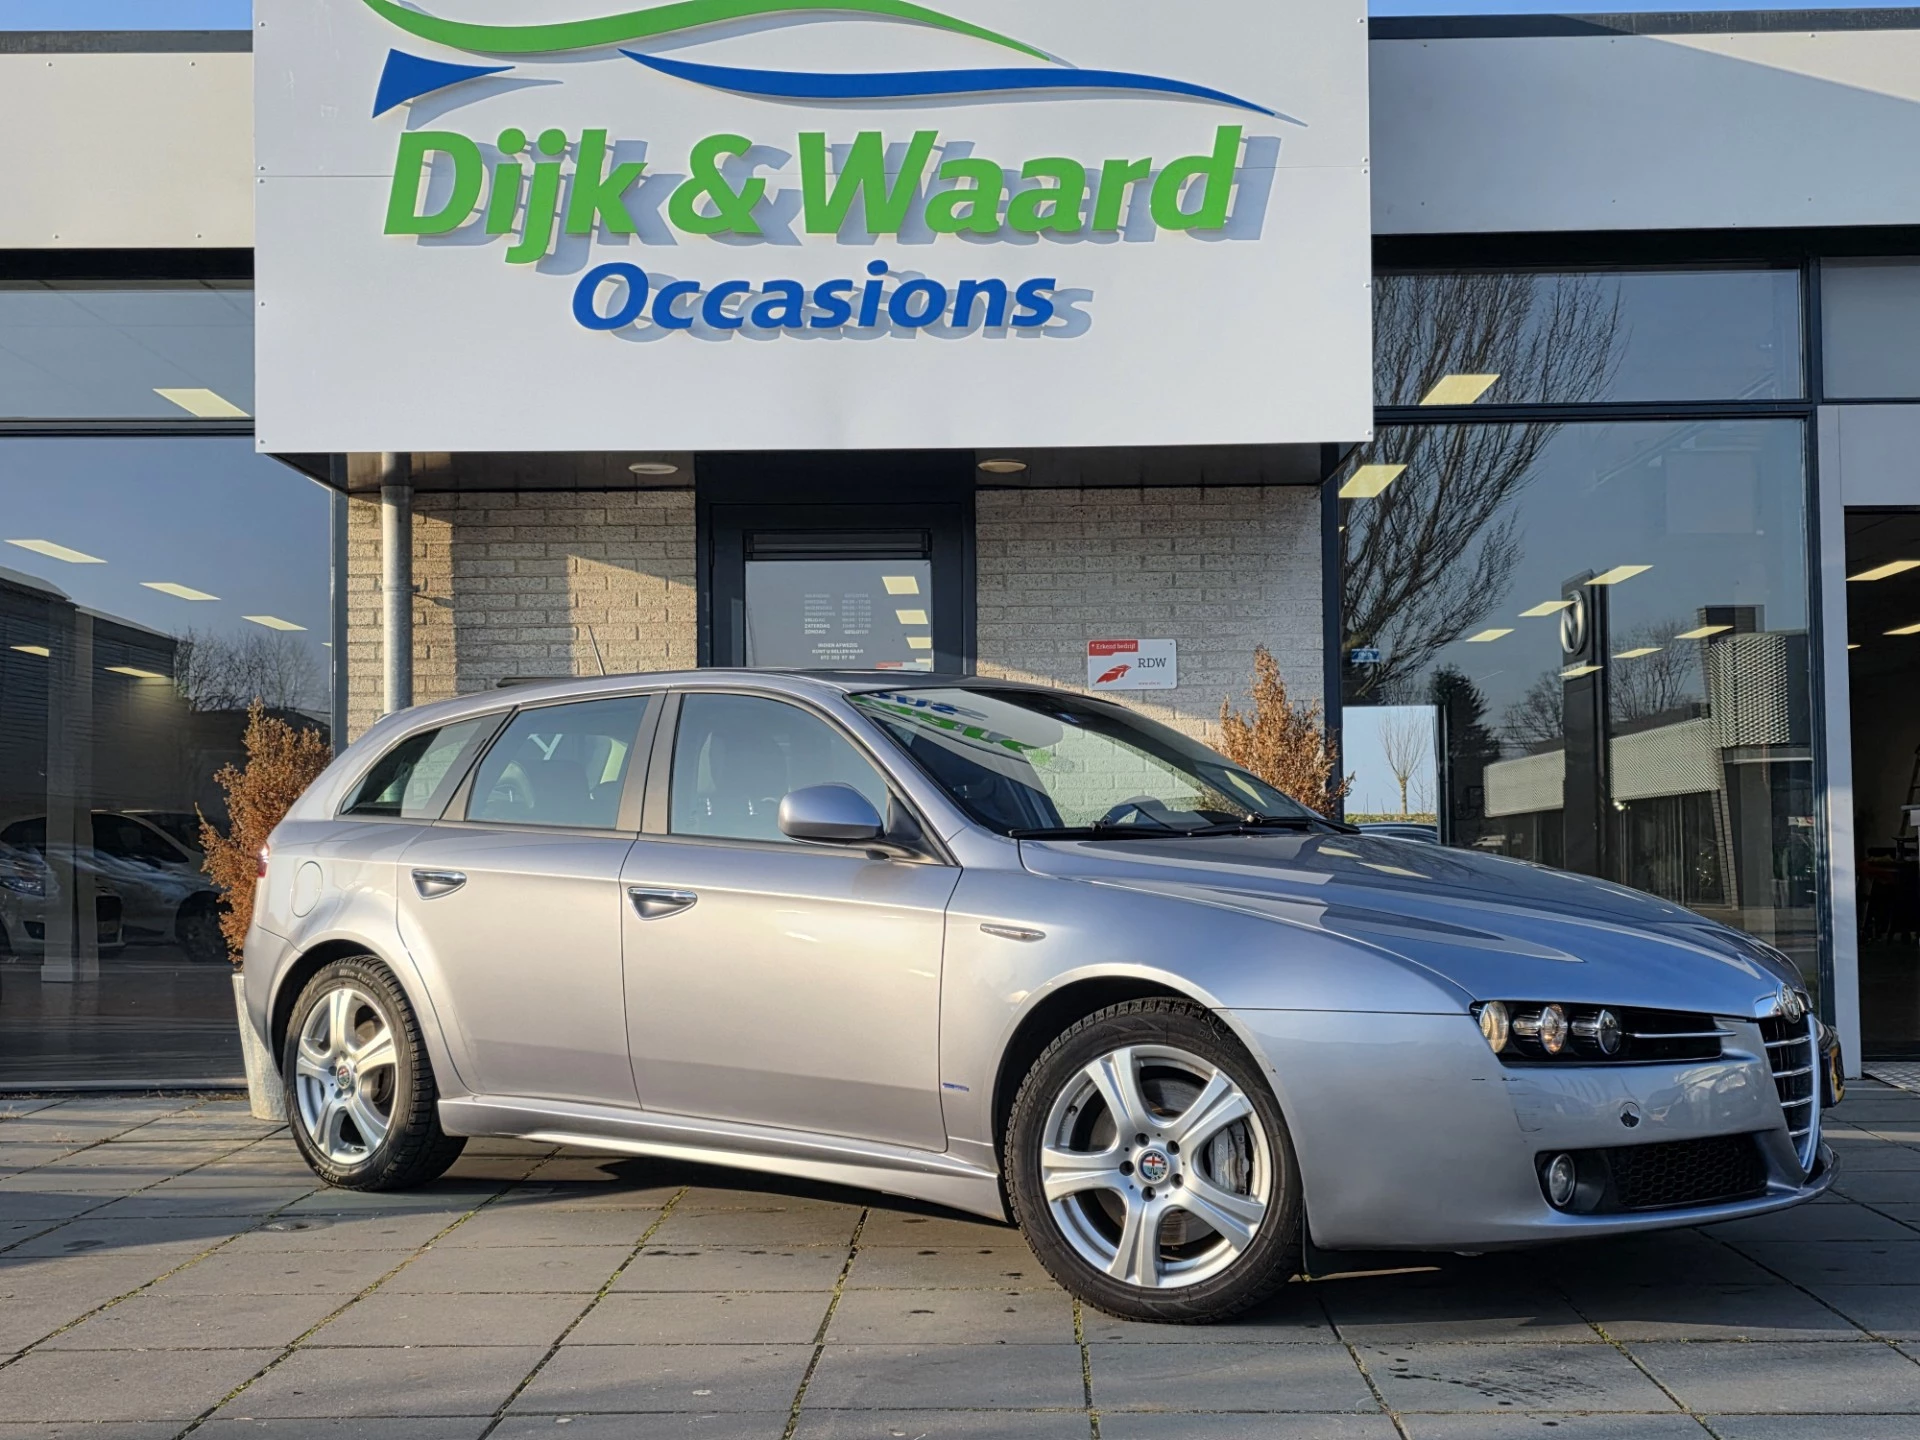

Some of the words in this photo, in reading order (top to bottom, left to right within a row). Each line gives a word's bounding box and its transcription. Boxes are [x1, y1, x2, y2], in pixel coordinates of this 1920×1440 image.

[384, 128, 645, 263] Dijk
[669, 134, 765, 234] &
[798, 125, 1242, 234] Waard
[573, 260, 1056, 329] Occasions
[1137, 657, 1167, 668] RDW
[313, 1165, 339, 1183] HIFLY
